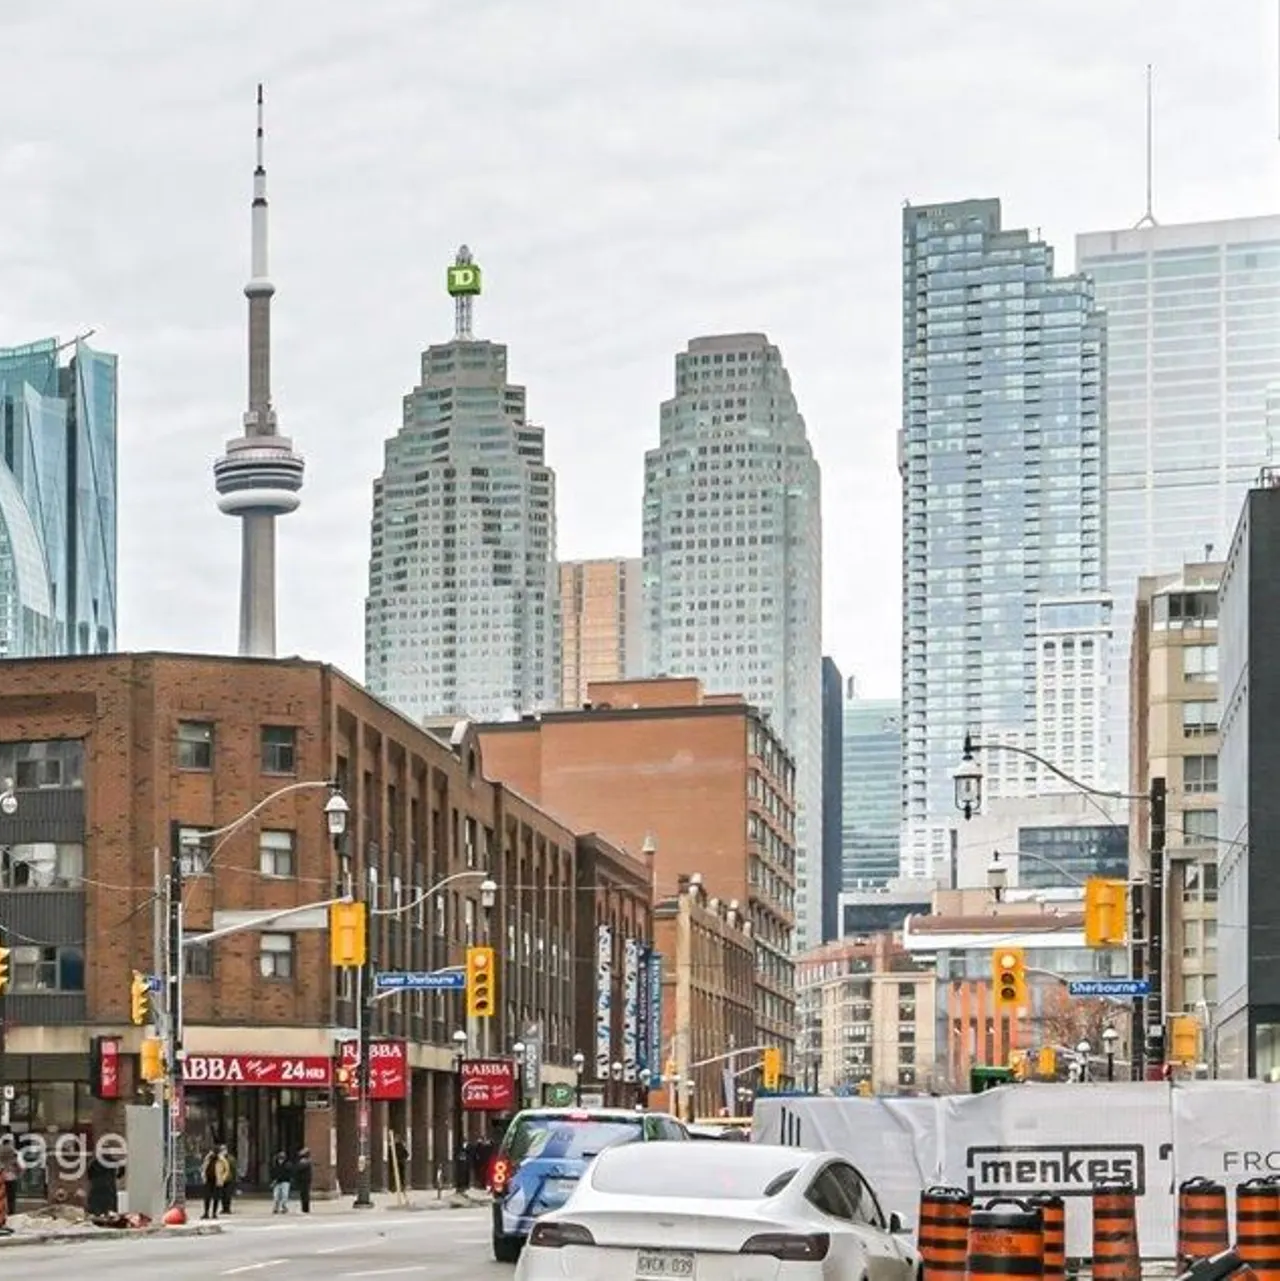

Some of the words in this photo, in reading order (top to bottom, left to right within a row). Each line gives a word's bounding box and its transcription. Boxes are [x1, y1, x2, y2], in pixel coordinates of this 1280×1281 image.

[451, 269, 473, 285] TD
[1072, 982, 1137, 993] Sherbourne
[342, 1044, 402, 1058] RBBA
[462, 1064, 510, 1076] RABBA
[980, 1156, 1133, 1183] menkes
